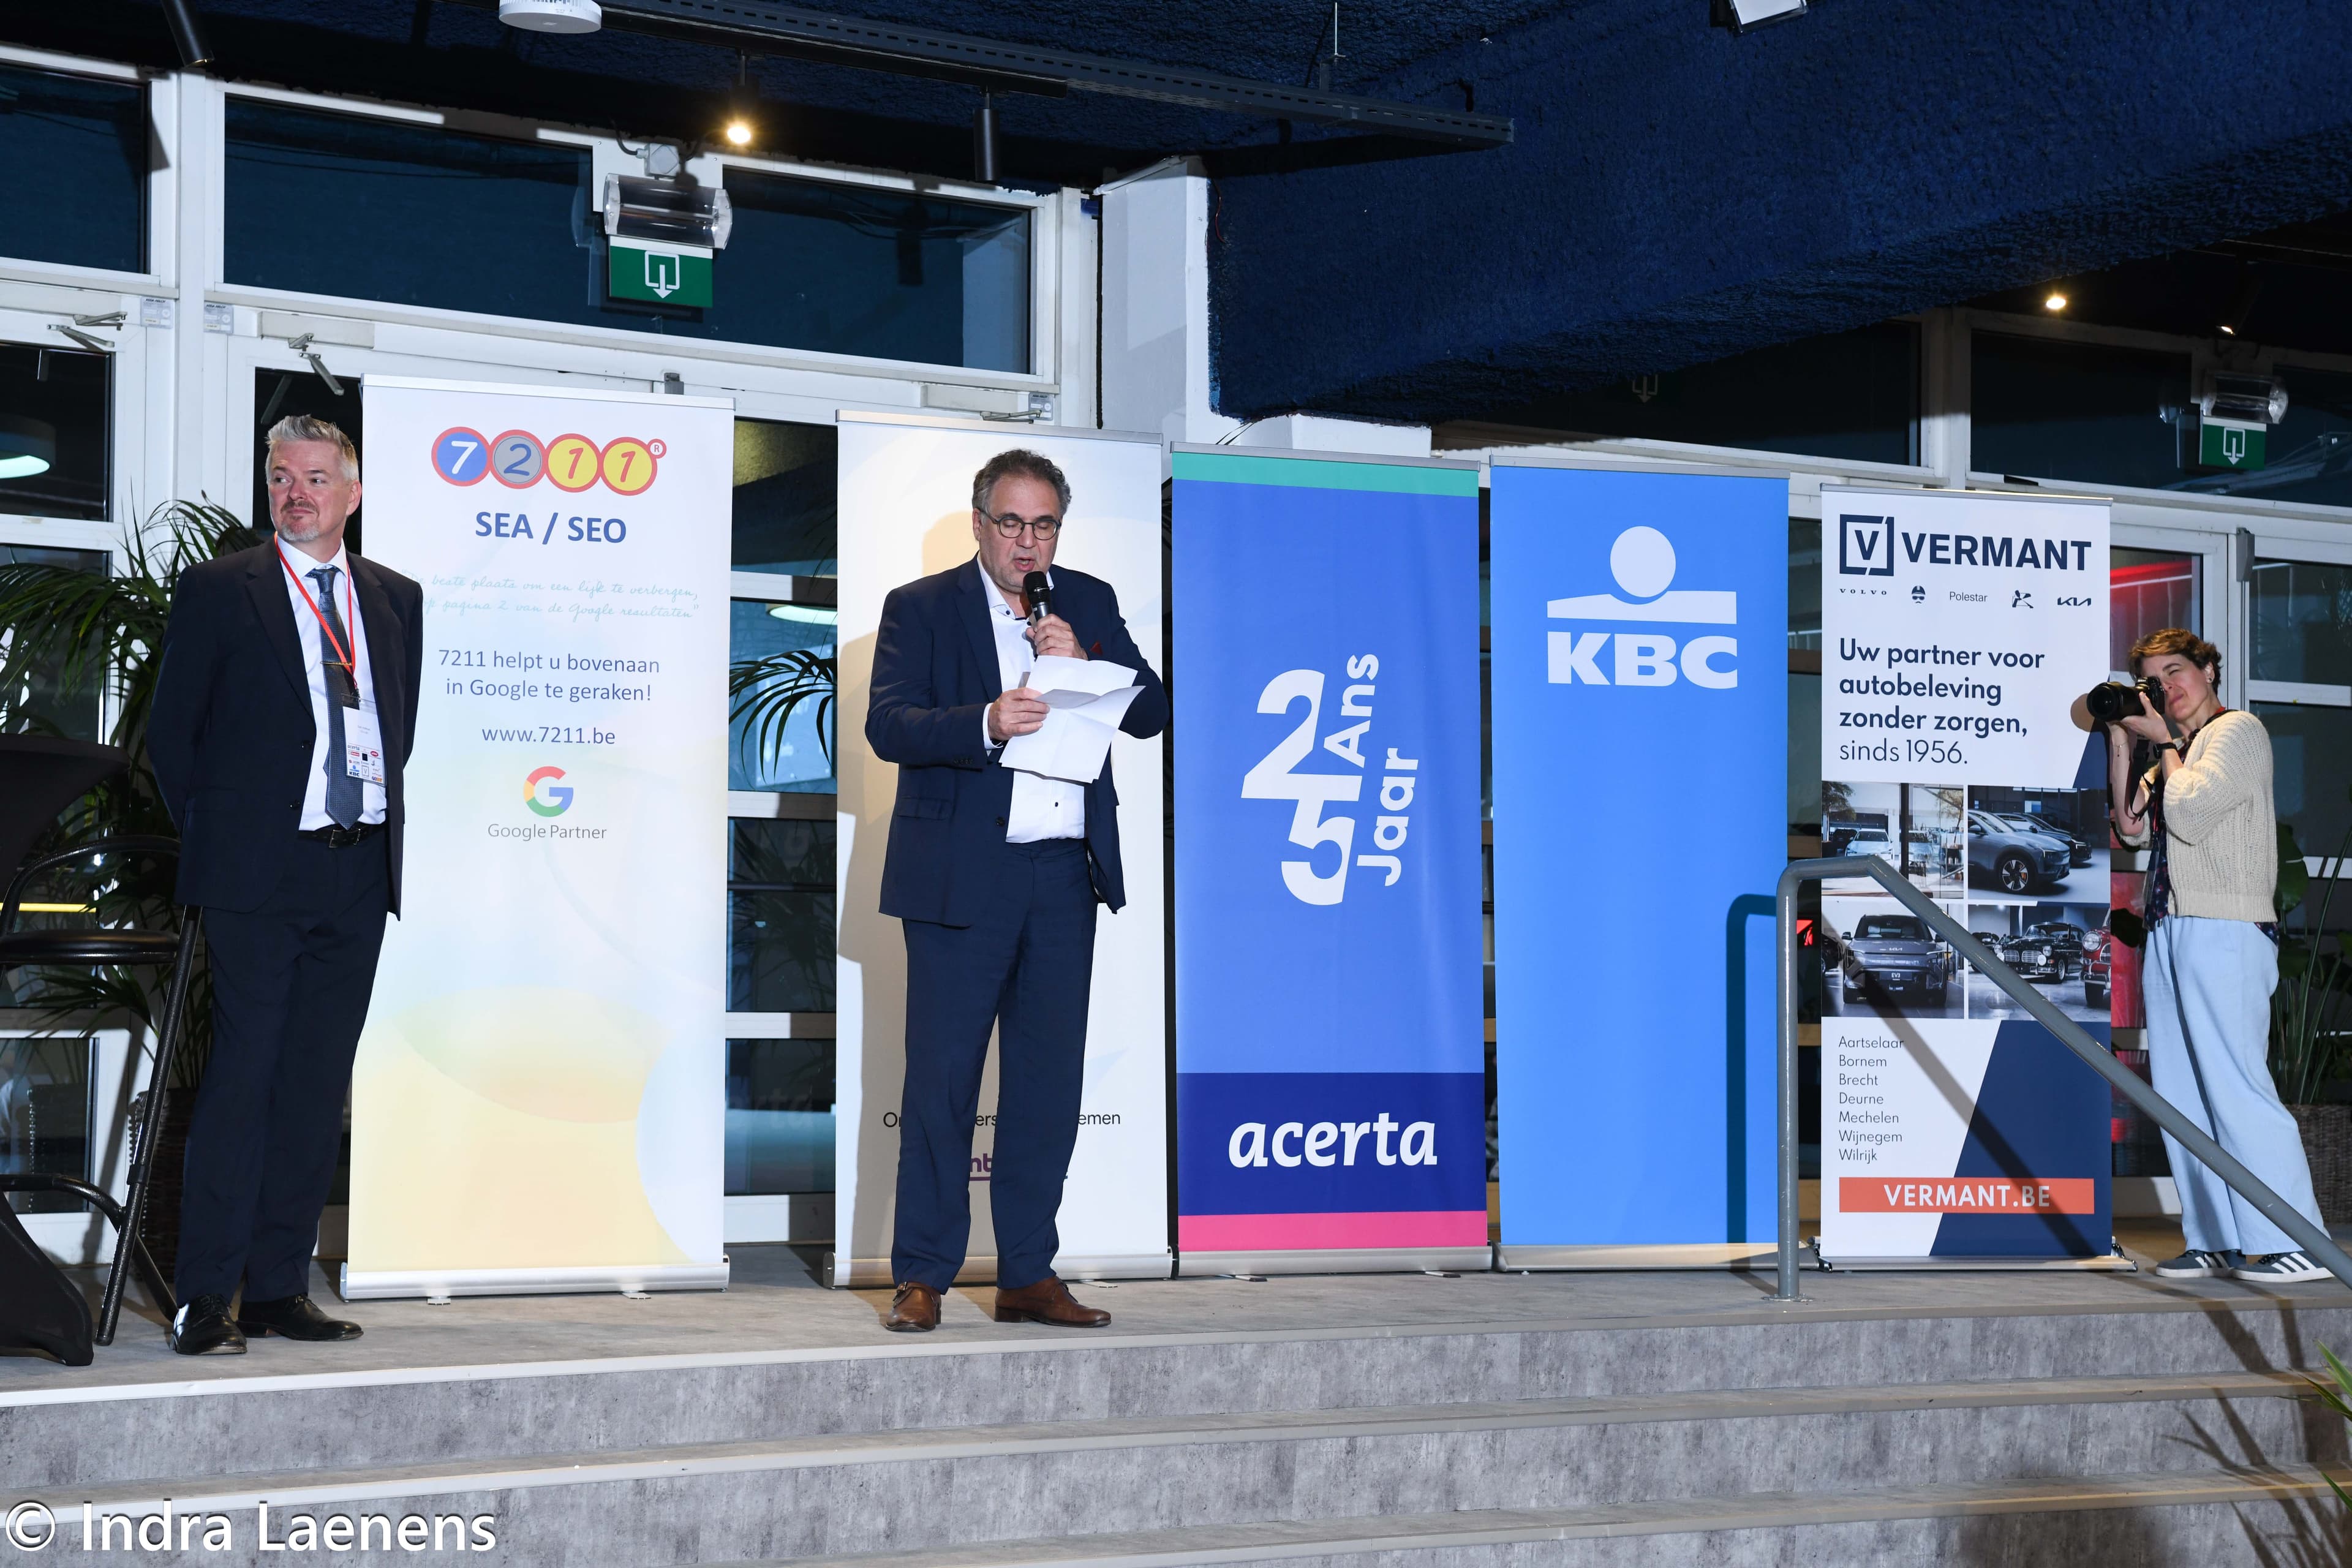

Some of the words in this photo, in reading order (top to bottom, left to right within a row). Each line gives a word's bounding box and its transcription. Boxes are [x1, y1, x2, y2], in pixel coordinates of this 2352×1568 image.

[476, 512, 535, 540] SEA
[543, 513, 559, 546] /
[568, 517, 627, 544] SEO
[1902, 532, 2092, 571] VERMANT
[432, 574, 467, 587] beste
[472, 576, 518, 591] plaats
[578, 581, 606, 599] lijk
[612, 583, 624, 594] te
[1950, 592, 1987, 603] Polestar
[442, 597, 492, 616] pagina
[497, 600, 510, 611] 2
[548, 603, 564, 613] de
[568, 604, 614, 623] Google
[439, 650, 486, 668] 7211
[494, 651, 543, 673] helpt
[550, 658, 560, 670] u
[568, 654, 660, 673] bovenaan
[1547, 631, 1738, 690] KBC
[1840, 638, 1880, 662] Uw
[1888, 644, 1981, 669] partner
[1988, 652, 2045, 668] voor
[447, 679, 463, 695] in
[470, 680, 539, 701] Google
[545, 684, 564, 699] te
[570, 684, 651, 703] geraken!
[1839, 673, 2002, 706] autobeleving
[1323, 654, 1379, 769] Ans
[1839, 705, 1927, 729] zonder
[1934, 715, 2028, 739] zorgen,
[482, 727, 616, 745] www.7211.be
[1839, 738, 1899, 761] sinds
[1906, 739, 1968, 764] 1956.
[1357, 747, 1419, 887] Jaar
[488, 824, 547, 842] Google
[551, 825, 608, 840] Partner
[1838, 1036, 1904, 1049] Aartselaar
[1839, 1055, 1888, 1068] Bornem
[1839, 1074, 1879, 1087] Brecht
[1839, 1092, 1885, 1105] Deurne
[1839, 1111, 1899, 1124] Mechelen
[1229, 1113, 1438, 1169] acerta
[1838, 1129, 1903, 1145] Wijnegem
[1838, 1148, 1878, 1164] Wilrijk
[1883, 1184, 2051, 1207] VERMANT.BE
